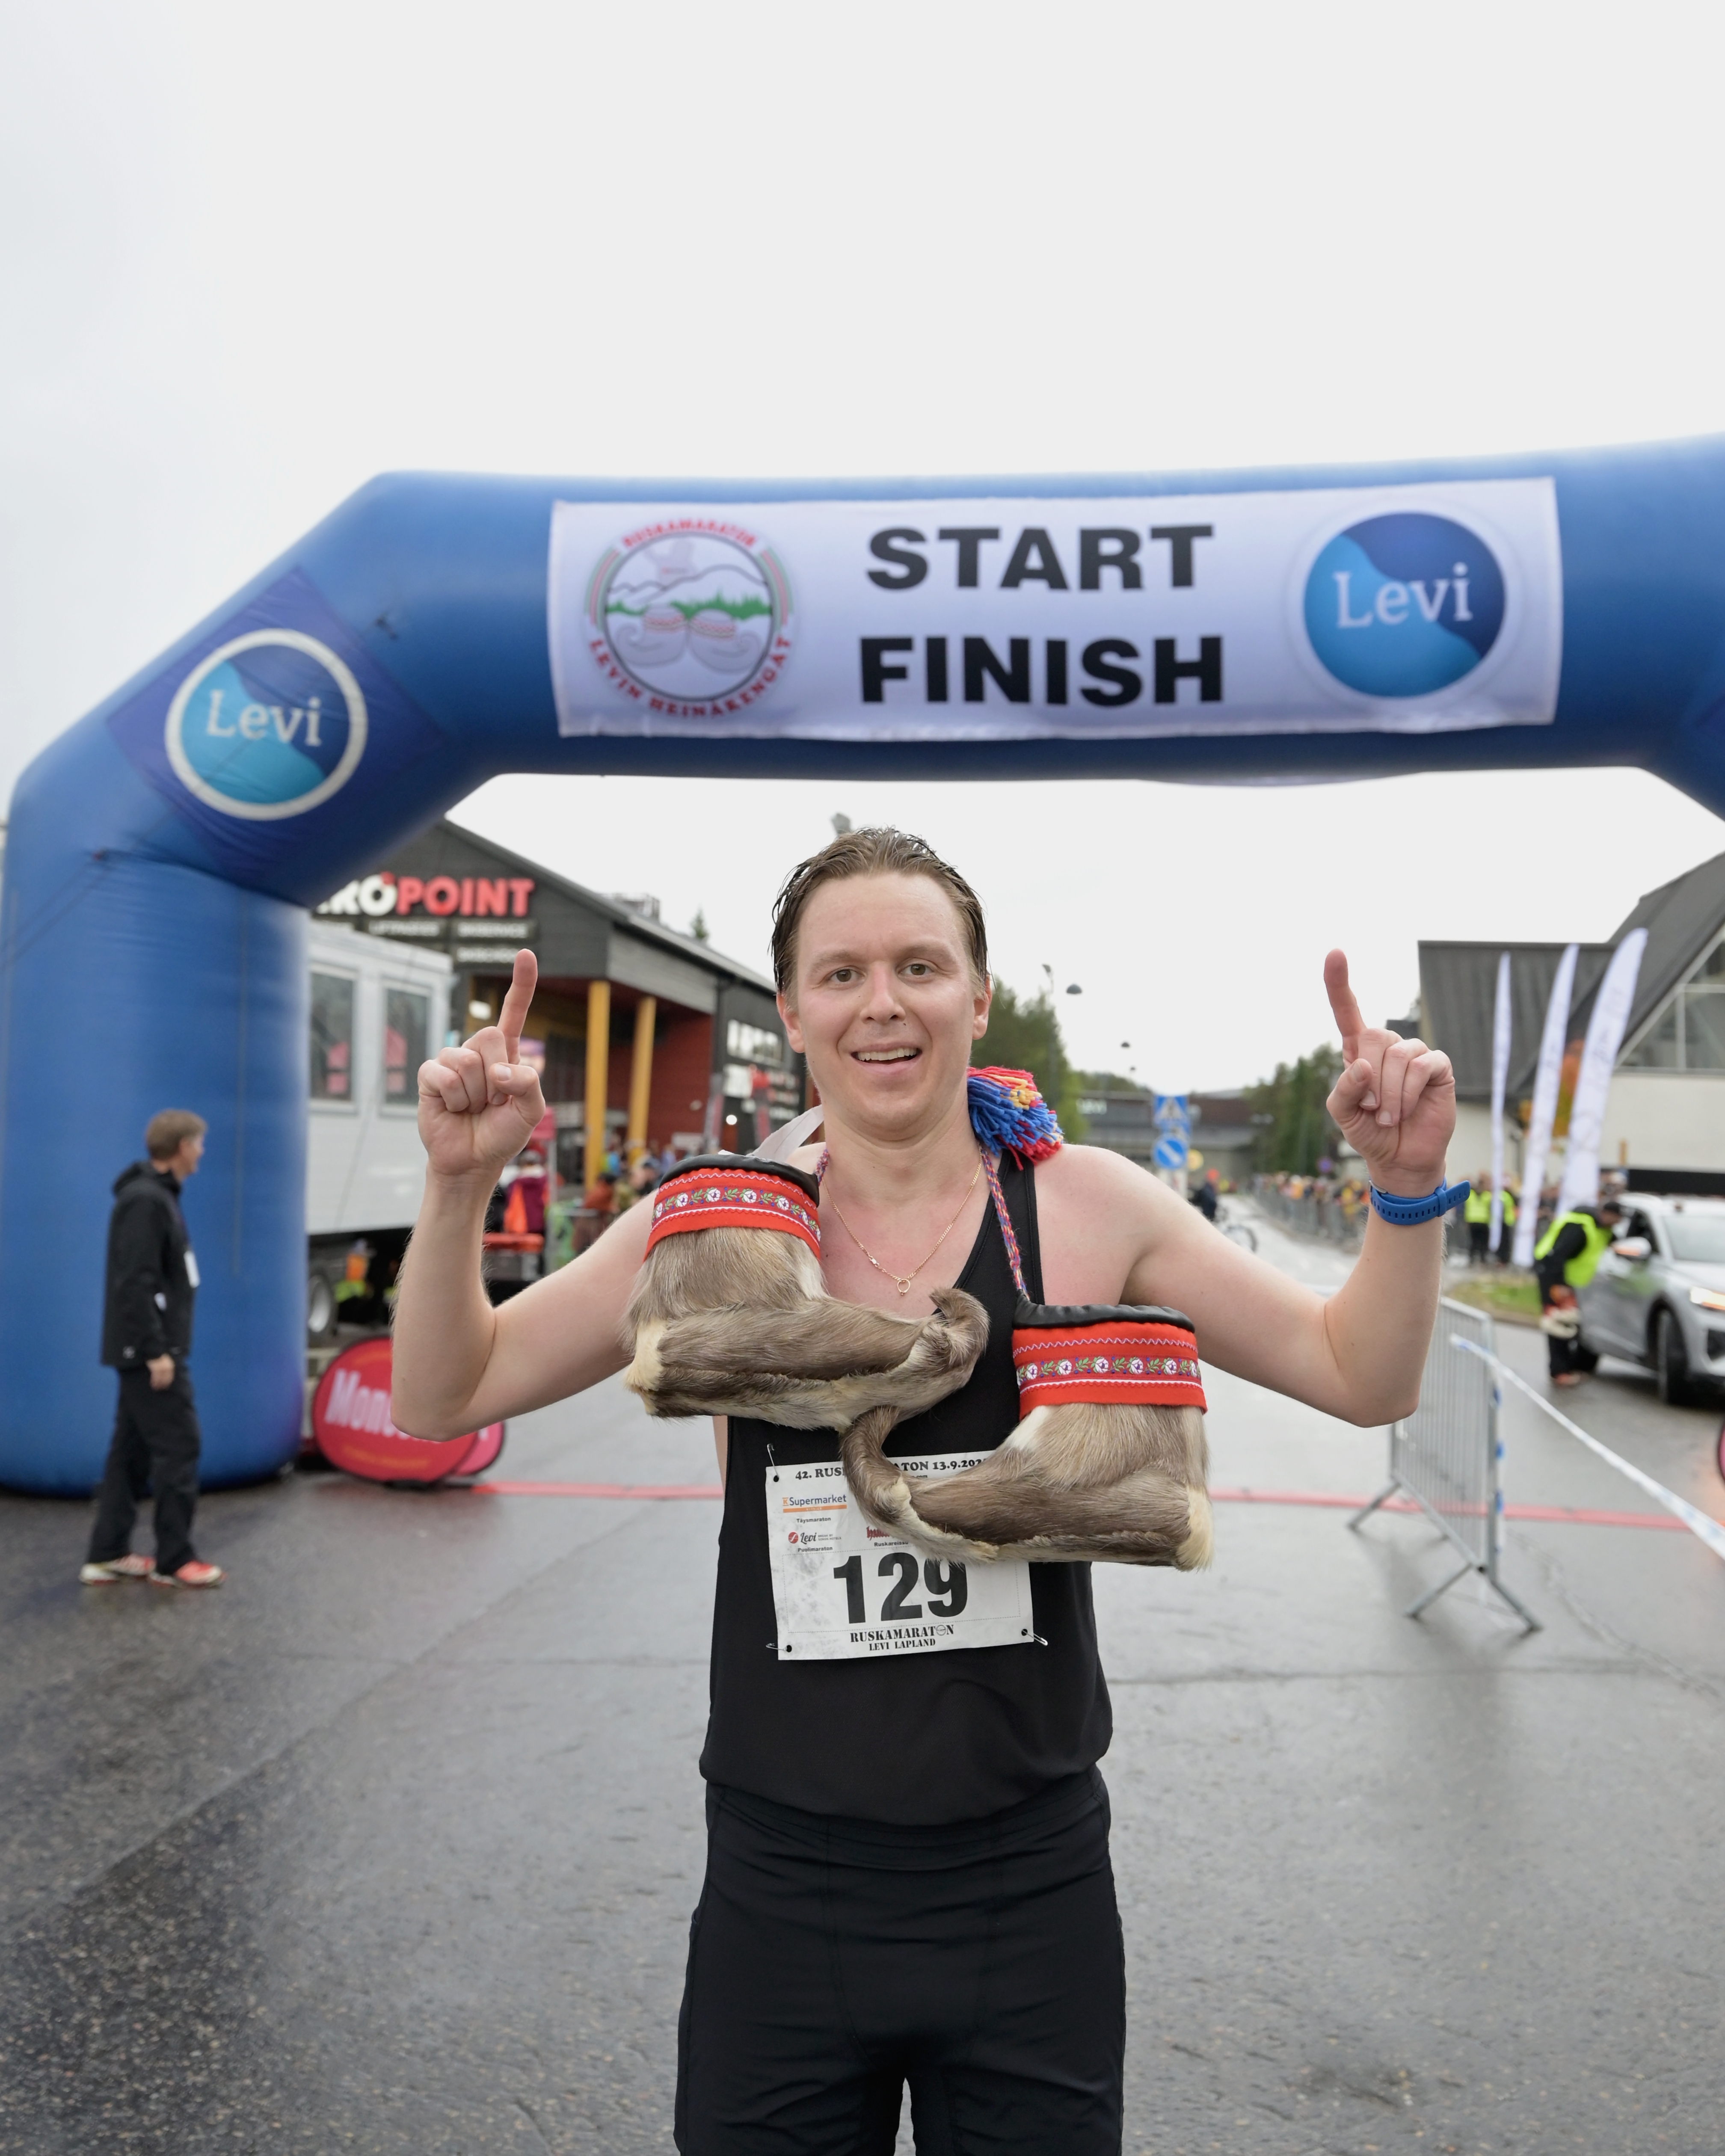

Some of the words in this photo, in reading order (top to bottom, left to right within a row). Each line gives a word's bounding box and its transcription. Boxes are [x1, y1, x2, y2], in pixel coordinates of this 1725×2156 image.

[867, 523, 1214, 591] START
[1332, 562, 1473, 628] Levi
[860, 635, 1224, 708] FINISH
[205, 688, 322, 747] Levi
[795, 1471, 812, 1480] 42.
[933, 1458, 986, 1470] 13.9.202
[800, 1532, 817, 1545] Levi
[833, 1552, 968, 1624] 129
[850, 1624, 954, 1643] RUSKAMARATON
[869, 1642, 889, 1651] LEVI
[895, 1638, 936, 1649] LAPLAND
